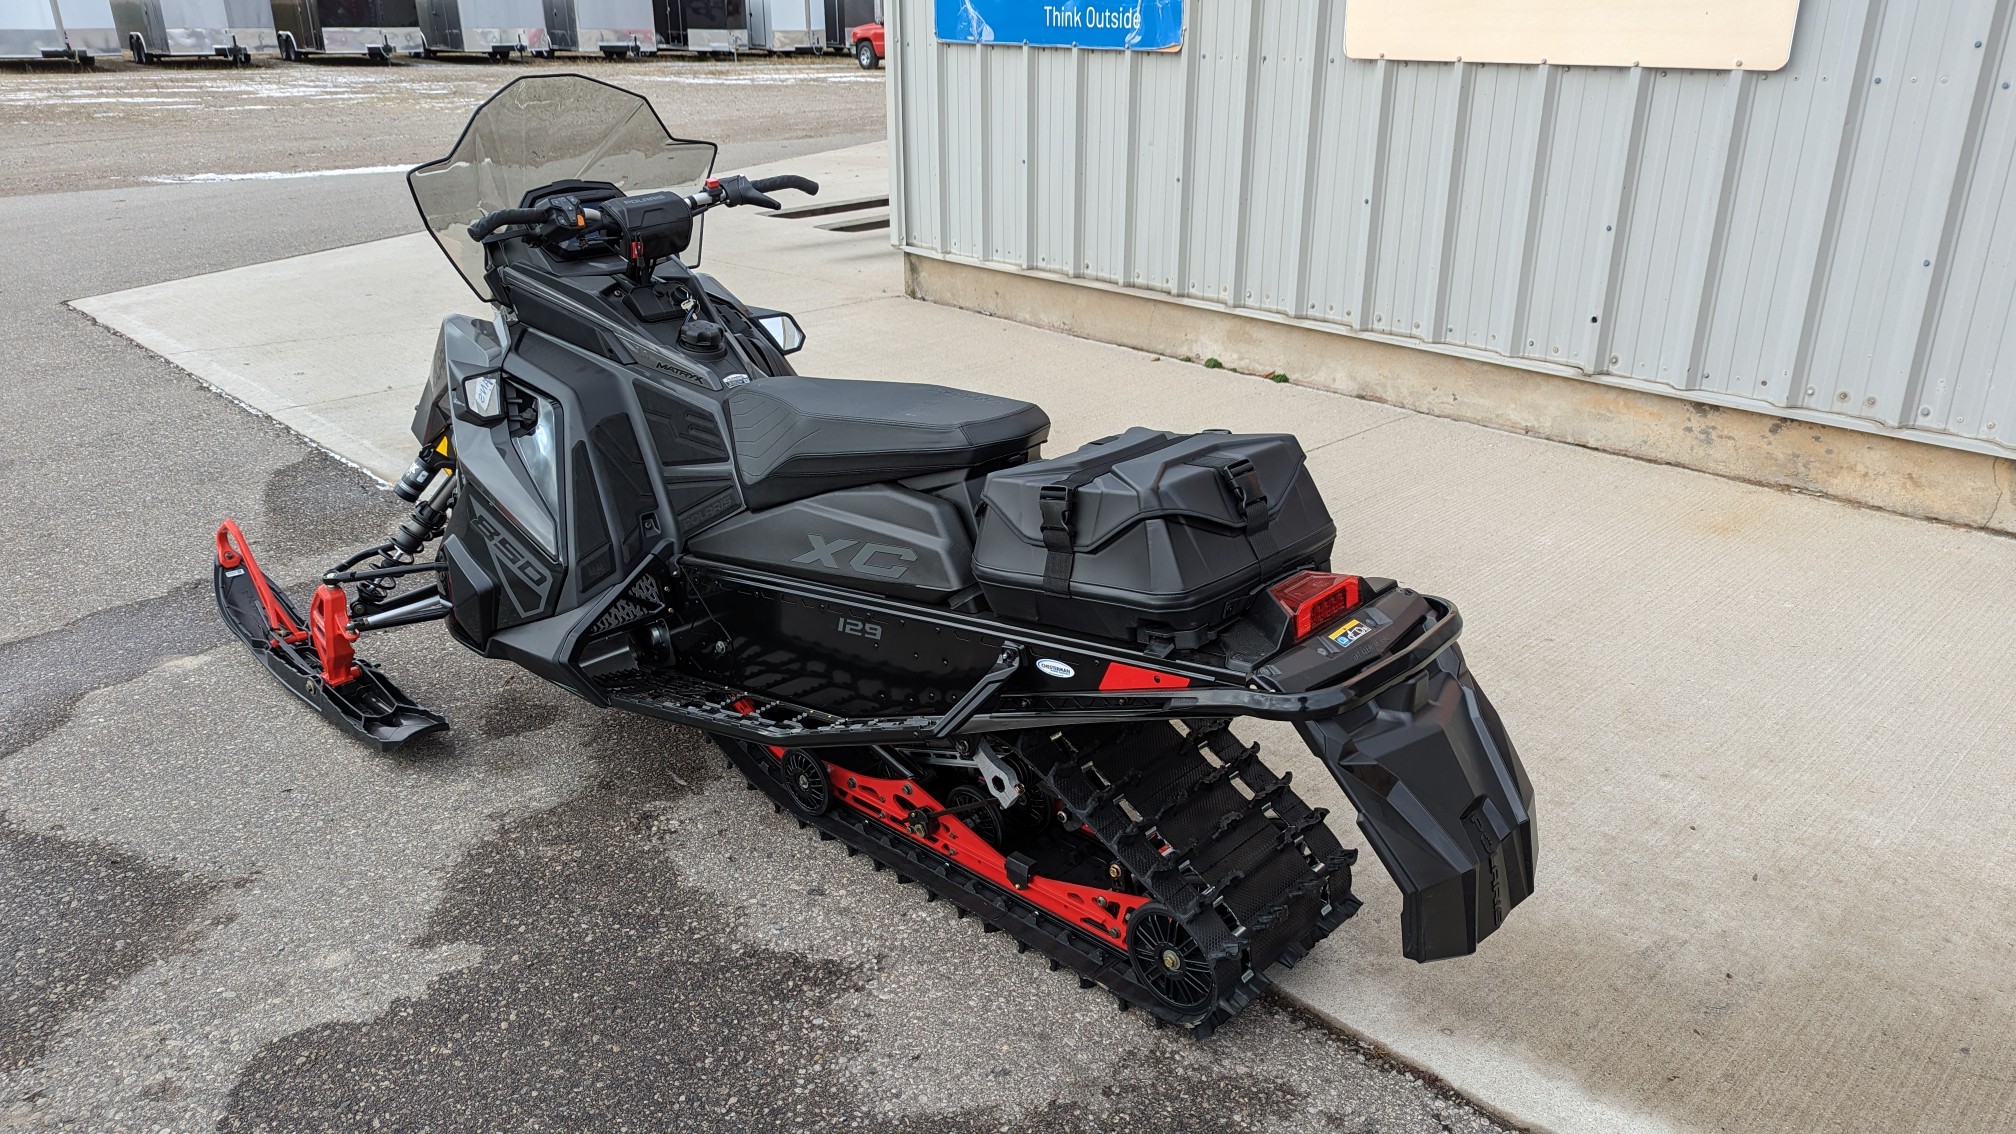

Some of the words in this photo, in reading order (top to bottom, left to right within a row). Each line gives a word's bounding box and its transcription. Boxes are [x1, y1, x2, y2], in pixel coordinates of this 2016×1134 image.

[1043, 6, 1083, 28] Think
[1086, 6, 1141, 29] Outside
[623, 194, 666, 205] POLARIS
[655, 361, 705, 385] MATRYX
[470, 514, 549, 588] 850
[790, 533, 919, 579] XC
[837, 617, 883, 640] 129
